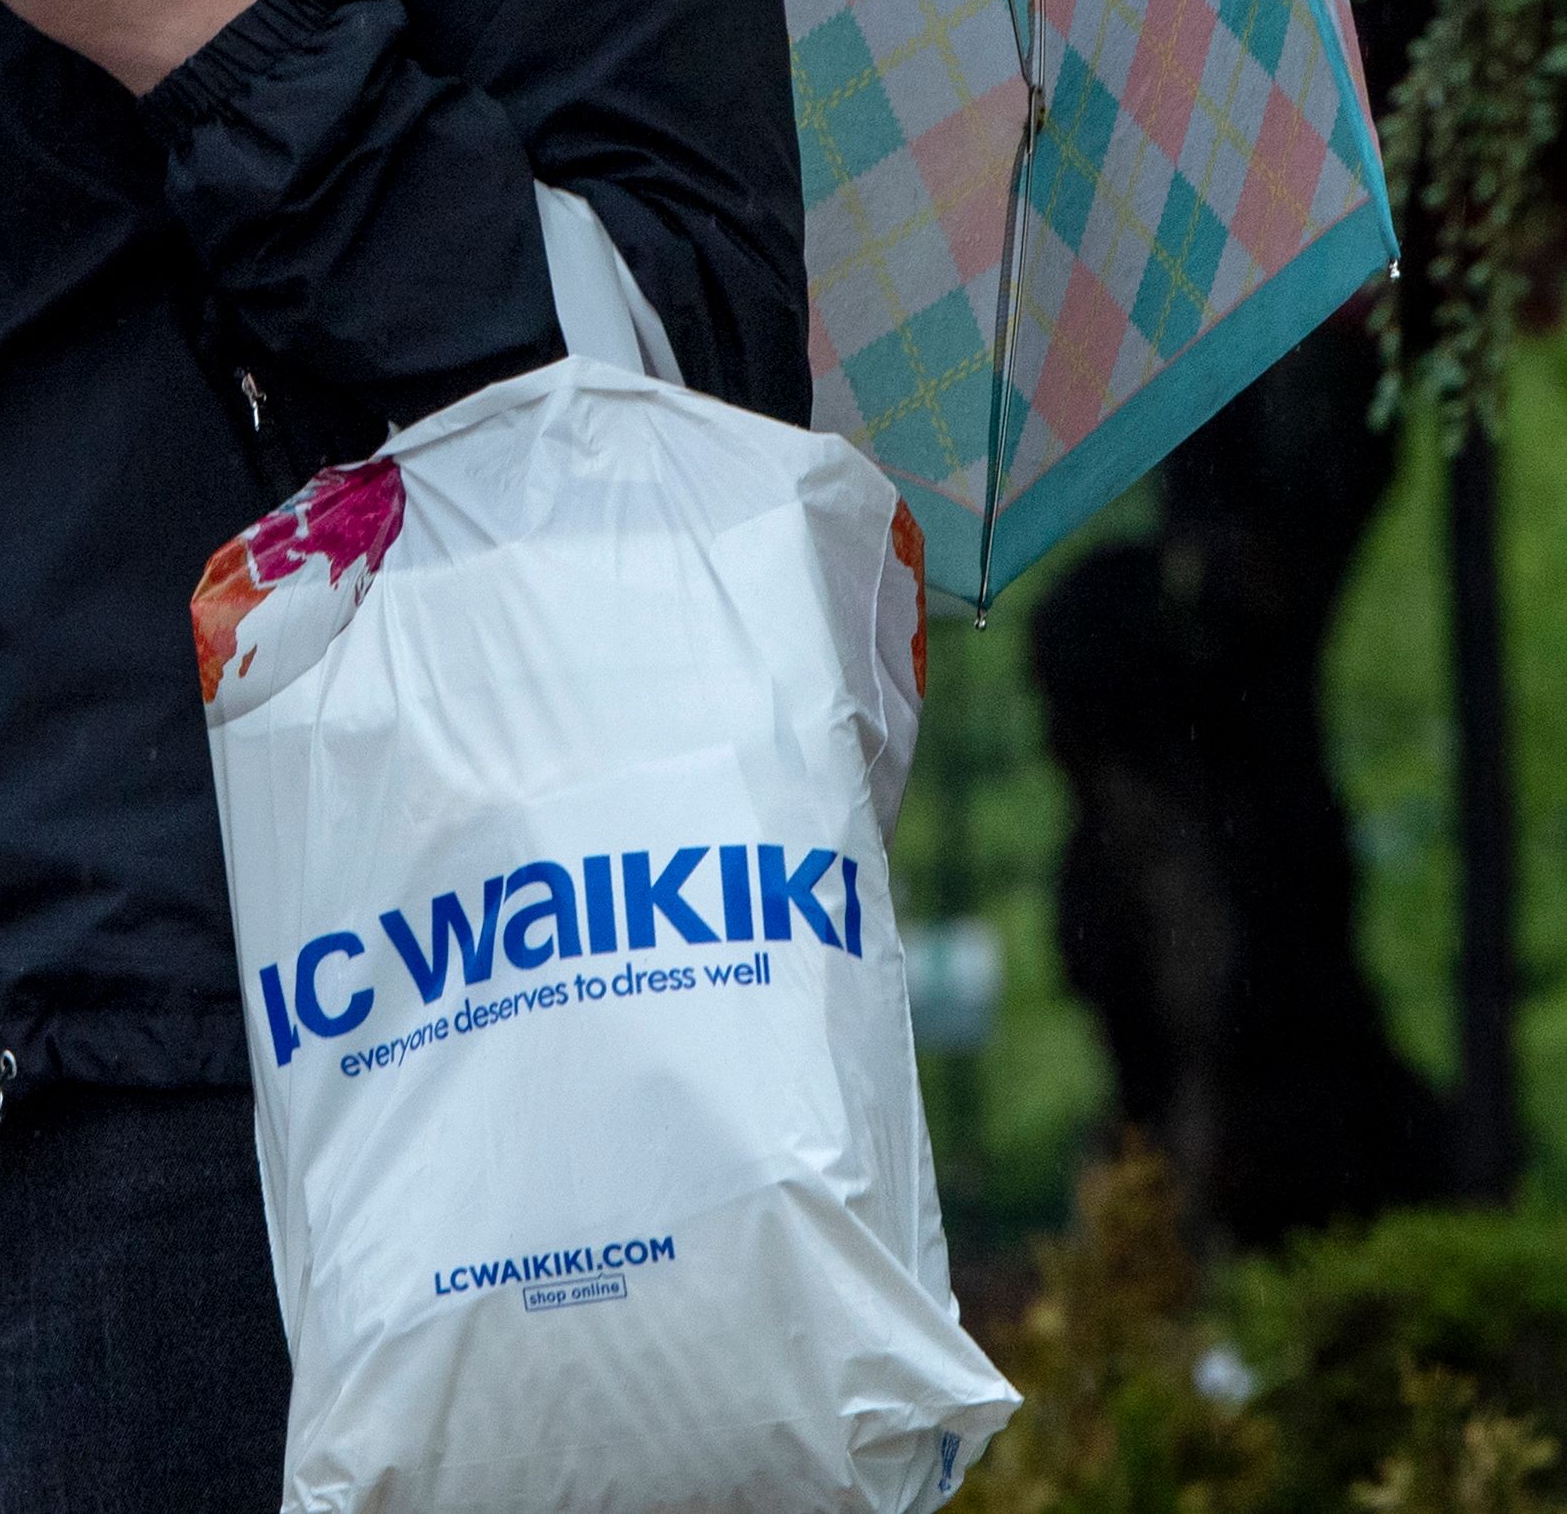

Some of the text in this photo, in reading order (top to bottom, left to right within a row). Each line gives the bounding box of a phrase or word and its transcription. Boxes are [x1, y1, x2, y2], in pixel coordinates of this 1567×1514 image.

[340, 951, 771, 1077] everyone deserves to dress well
[434, 1235, 676, 1297] LCWAIKIKI.COM
[528, 1280, 620, 1307] shop online
